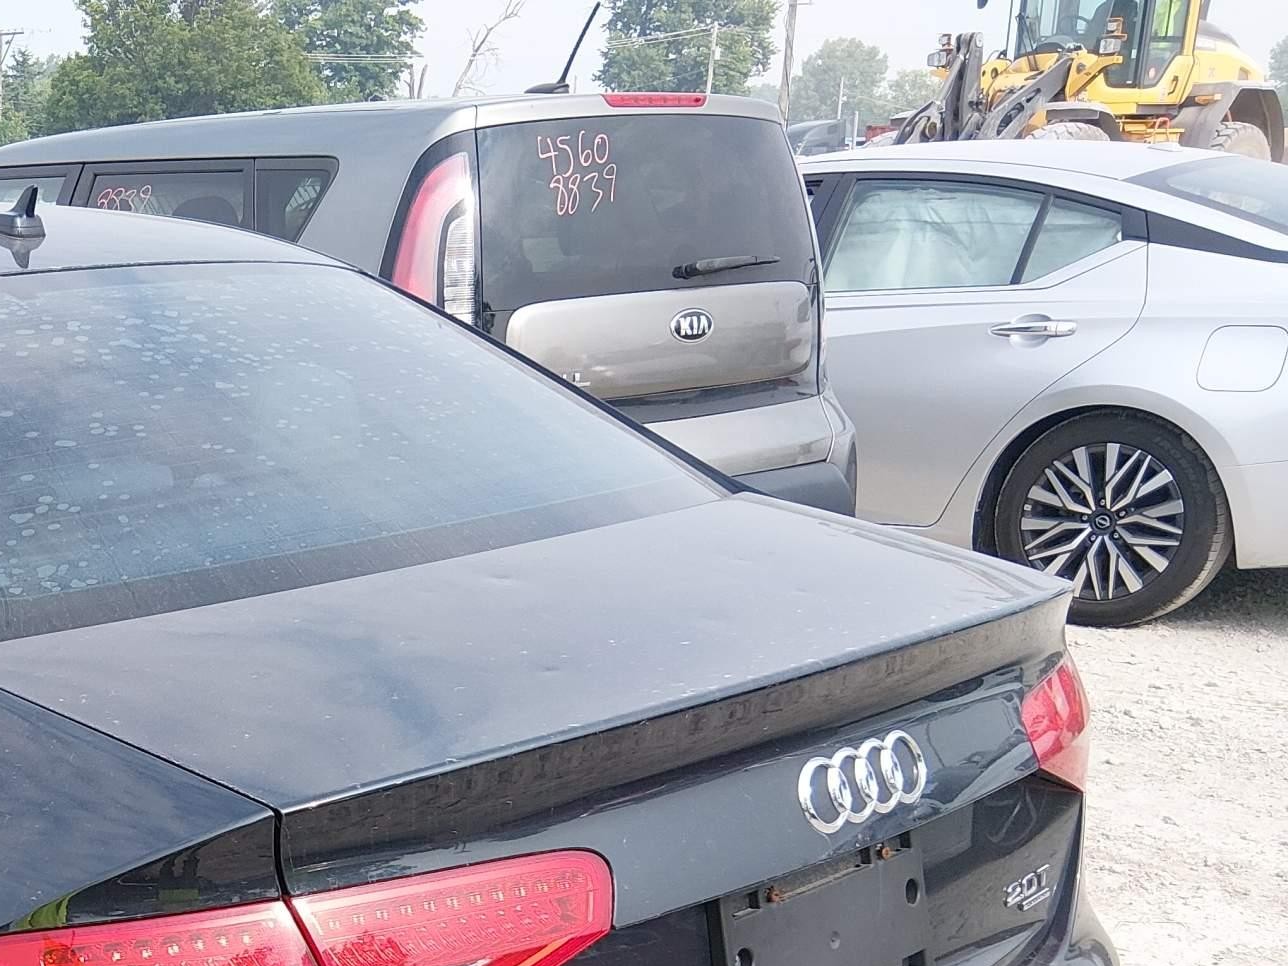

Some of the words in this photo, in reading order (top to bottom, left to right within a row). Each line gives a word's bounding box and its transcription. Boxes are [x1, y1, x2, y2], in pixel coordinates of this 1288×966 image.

[536, 130, 610, 177] 4560
[549, 163, 617, 216] 8839
[679, 315, 709, 336] KIA
